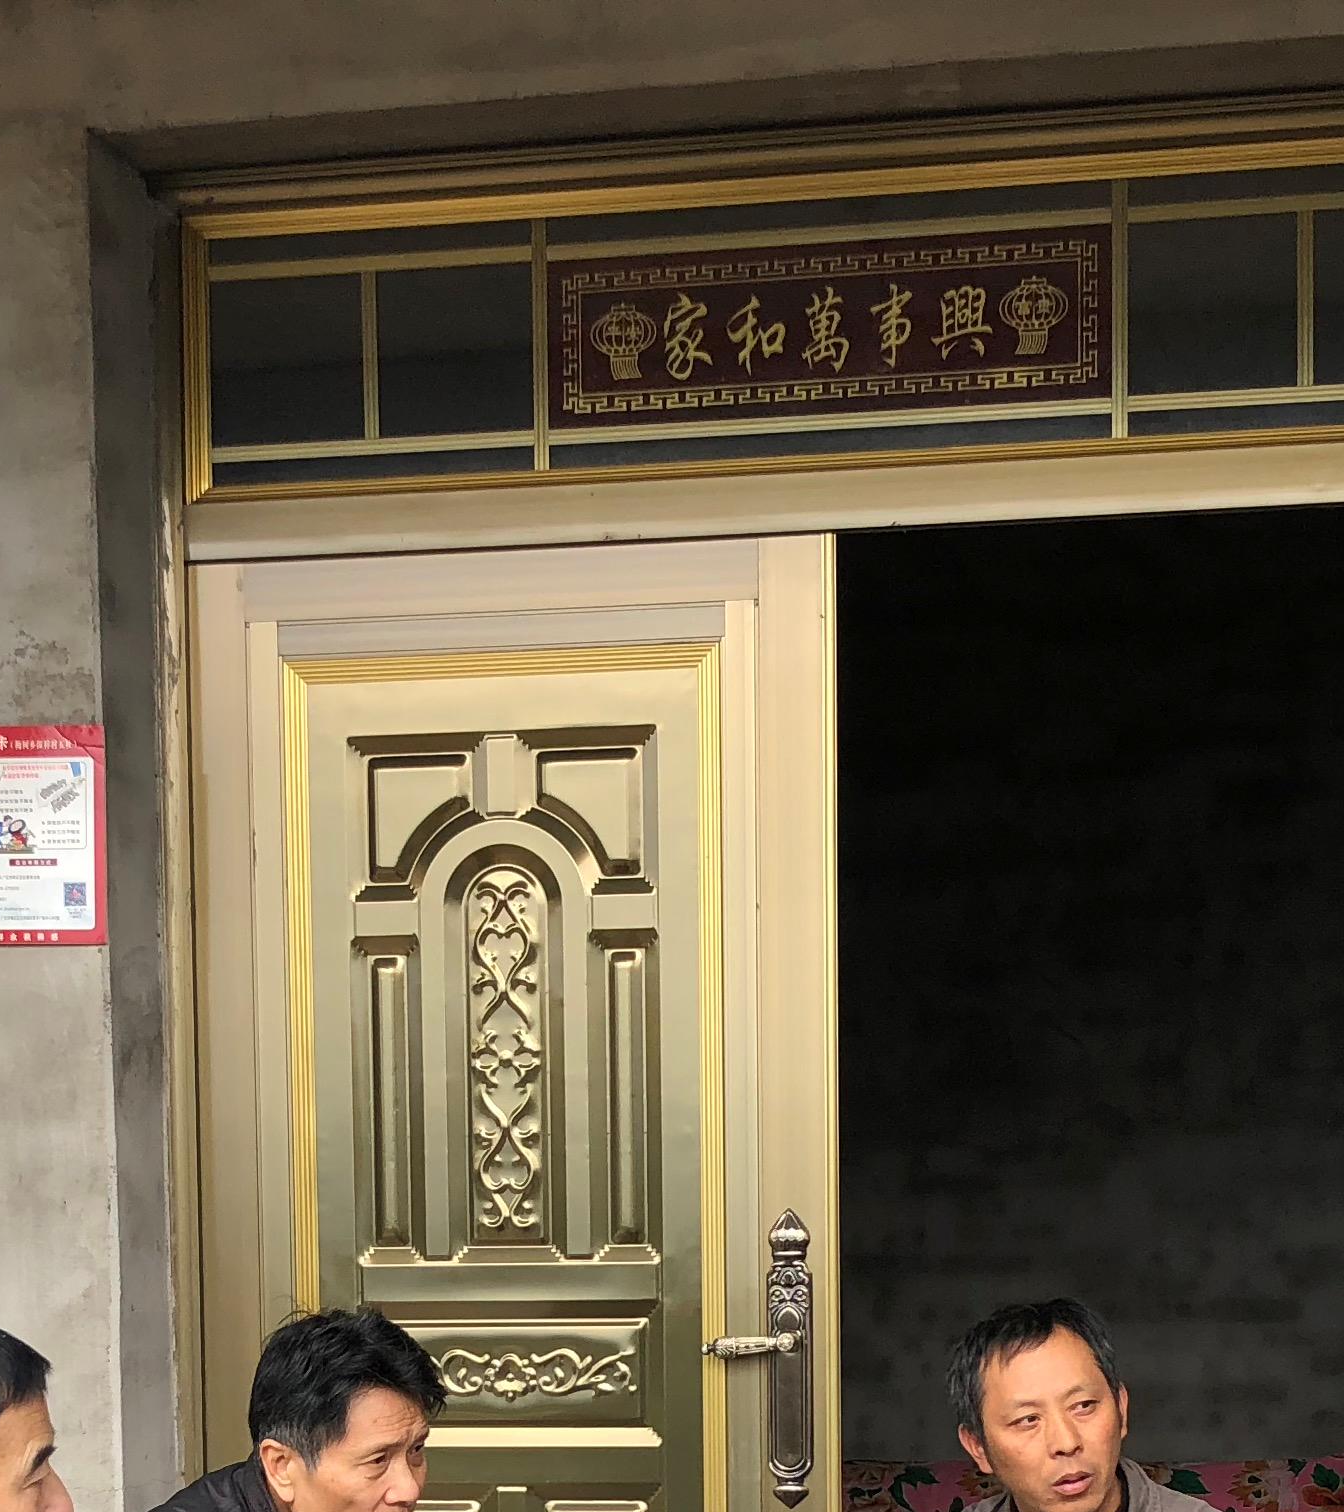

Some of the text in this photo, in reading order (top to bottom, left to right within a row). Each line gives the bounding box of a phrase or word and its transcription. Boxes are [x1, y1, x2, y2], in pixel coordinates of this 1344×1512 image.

[662, 283, 995, 380] 家和萬事興
